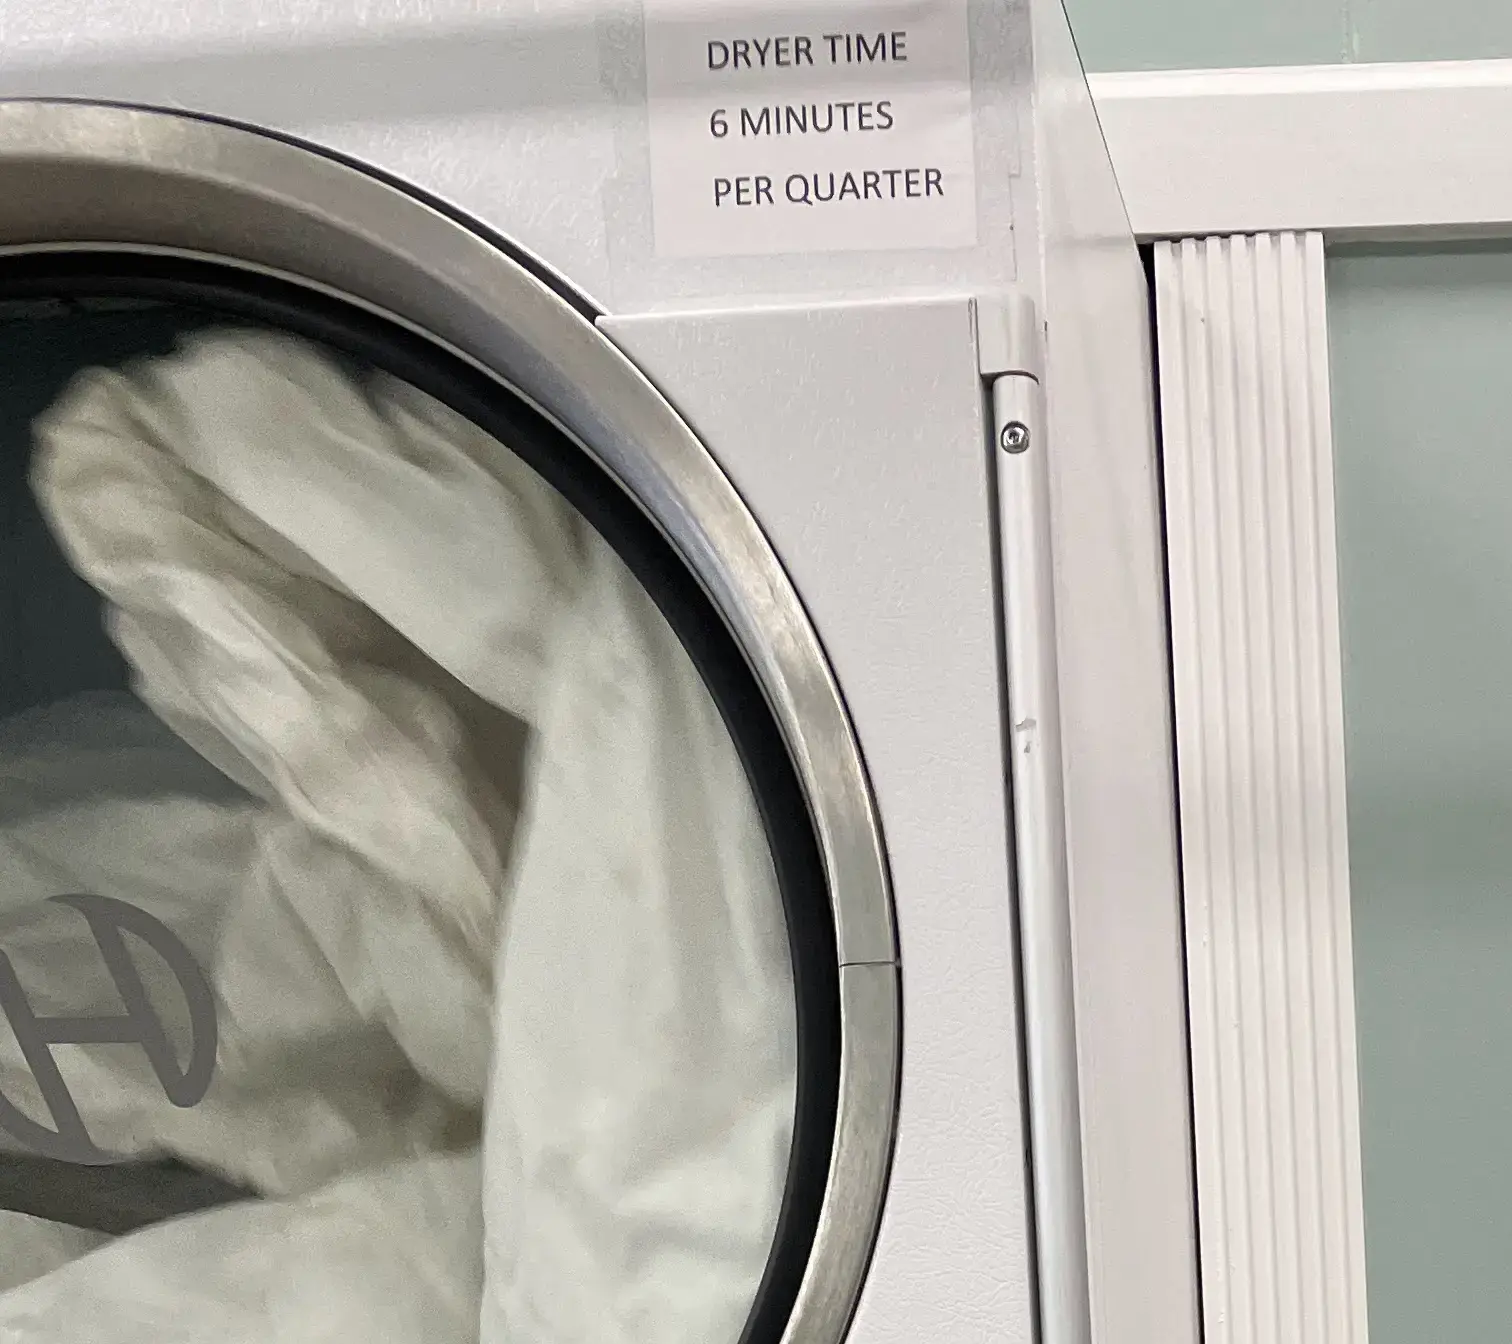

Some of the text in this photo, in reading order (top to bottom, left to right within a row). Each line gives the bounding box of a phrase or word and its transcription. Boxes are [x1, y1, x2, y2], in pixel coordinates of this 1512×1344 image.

[707, 31, 908, 71] DRYER TIME
[709, 100, 894, 138] 6 MINUTES
[713, 168, 945, 207] PER QUARTER
